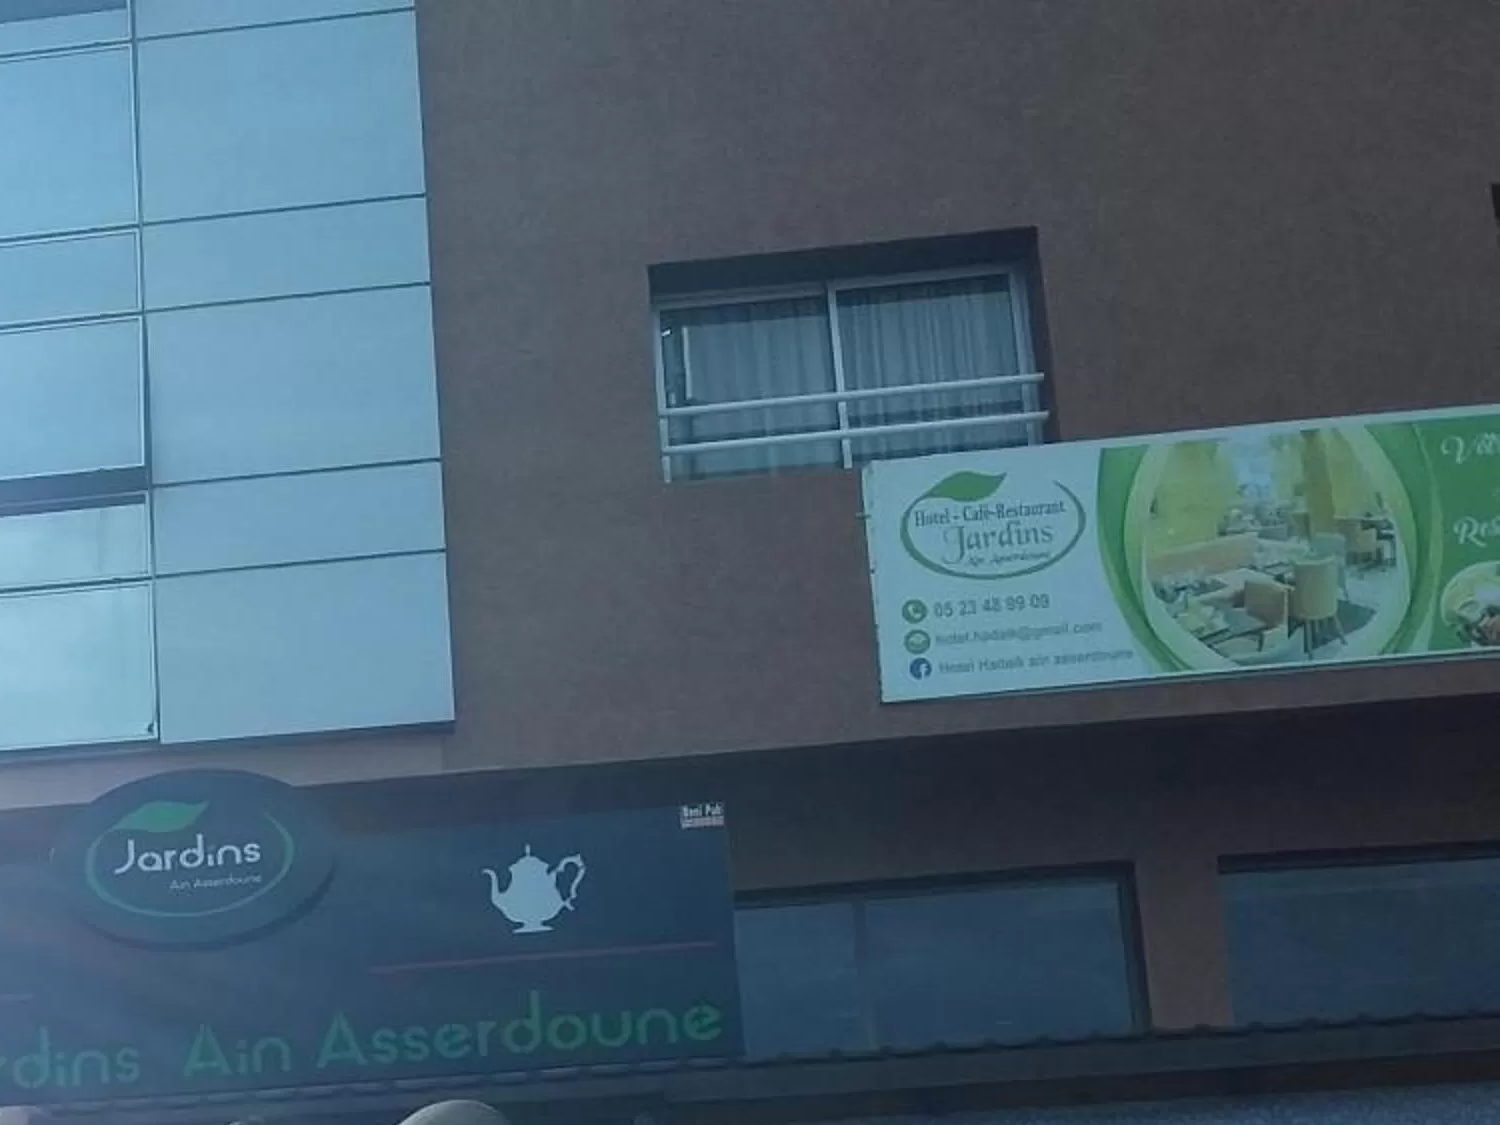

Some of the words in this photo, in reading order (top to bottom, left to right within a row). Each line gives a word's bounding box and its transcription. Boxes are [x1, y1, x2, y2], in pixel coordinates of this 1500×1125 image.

[915, 508, 950, 527] Hotel
[941, 521, 1053, 564] Jardins
[934, 601, 953, 617] 05
[959, 599, 977, 616] 23
[113, 832, 261, 875] Jardins
[182, 1022, 292, 1076] Ain
[316, 990, 722, 1068] Asserdoune
